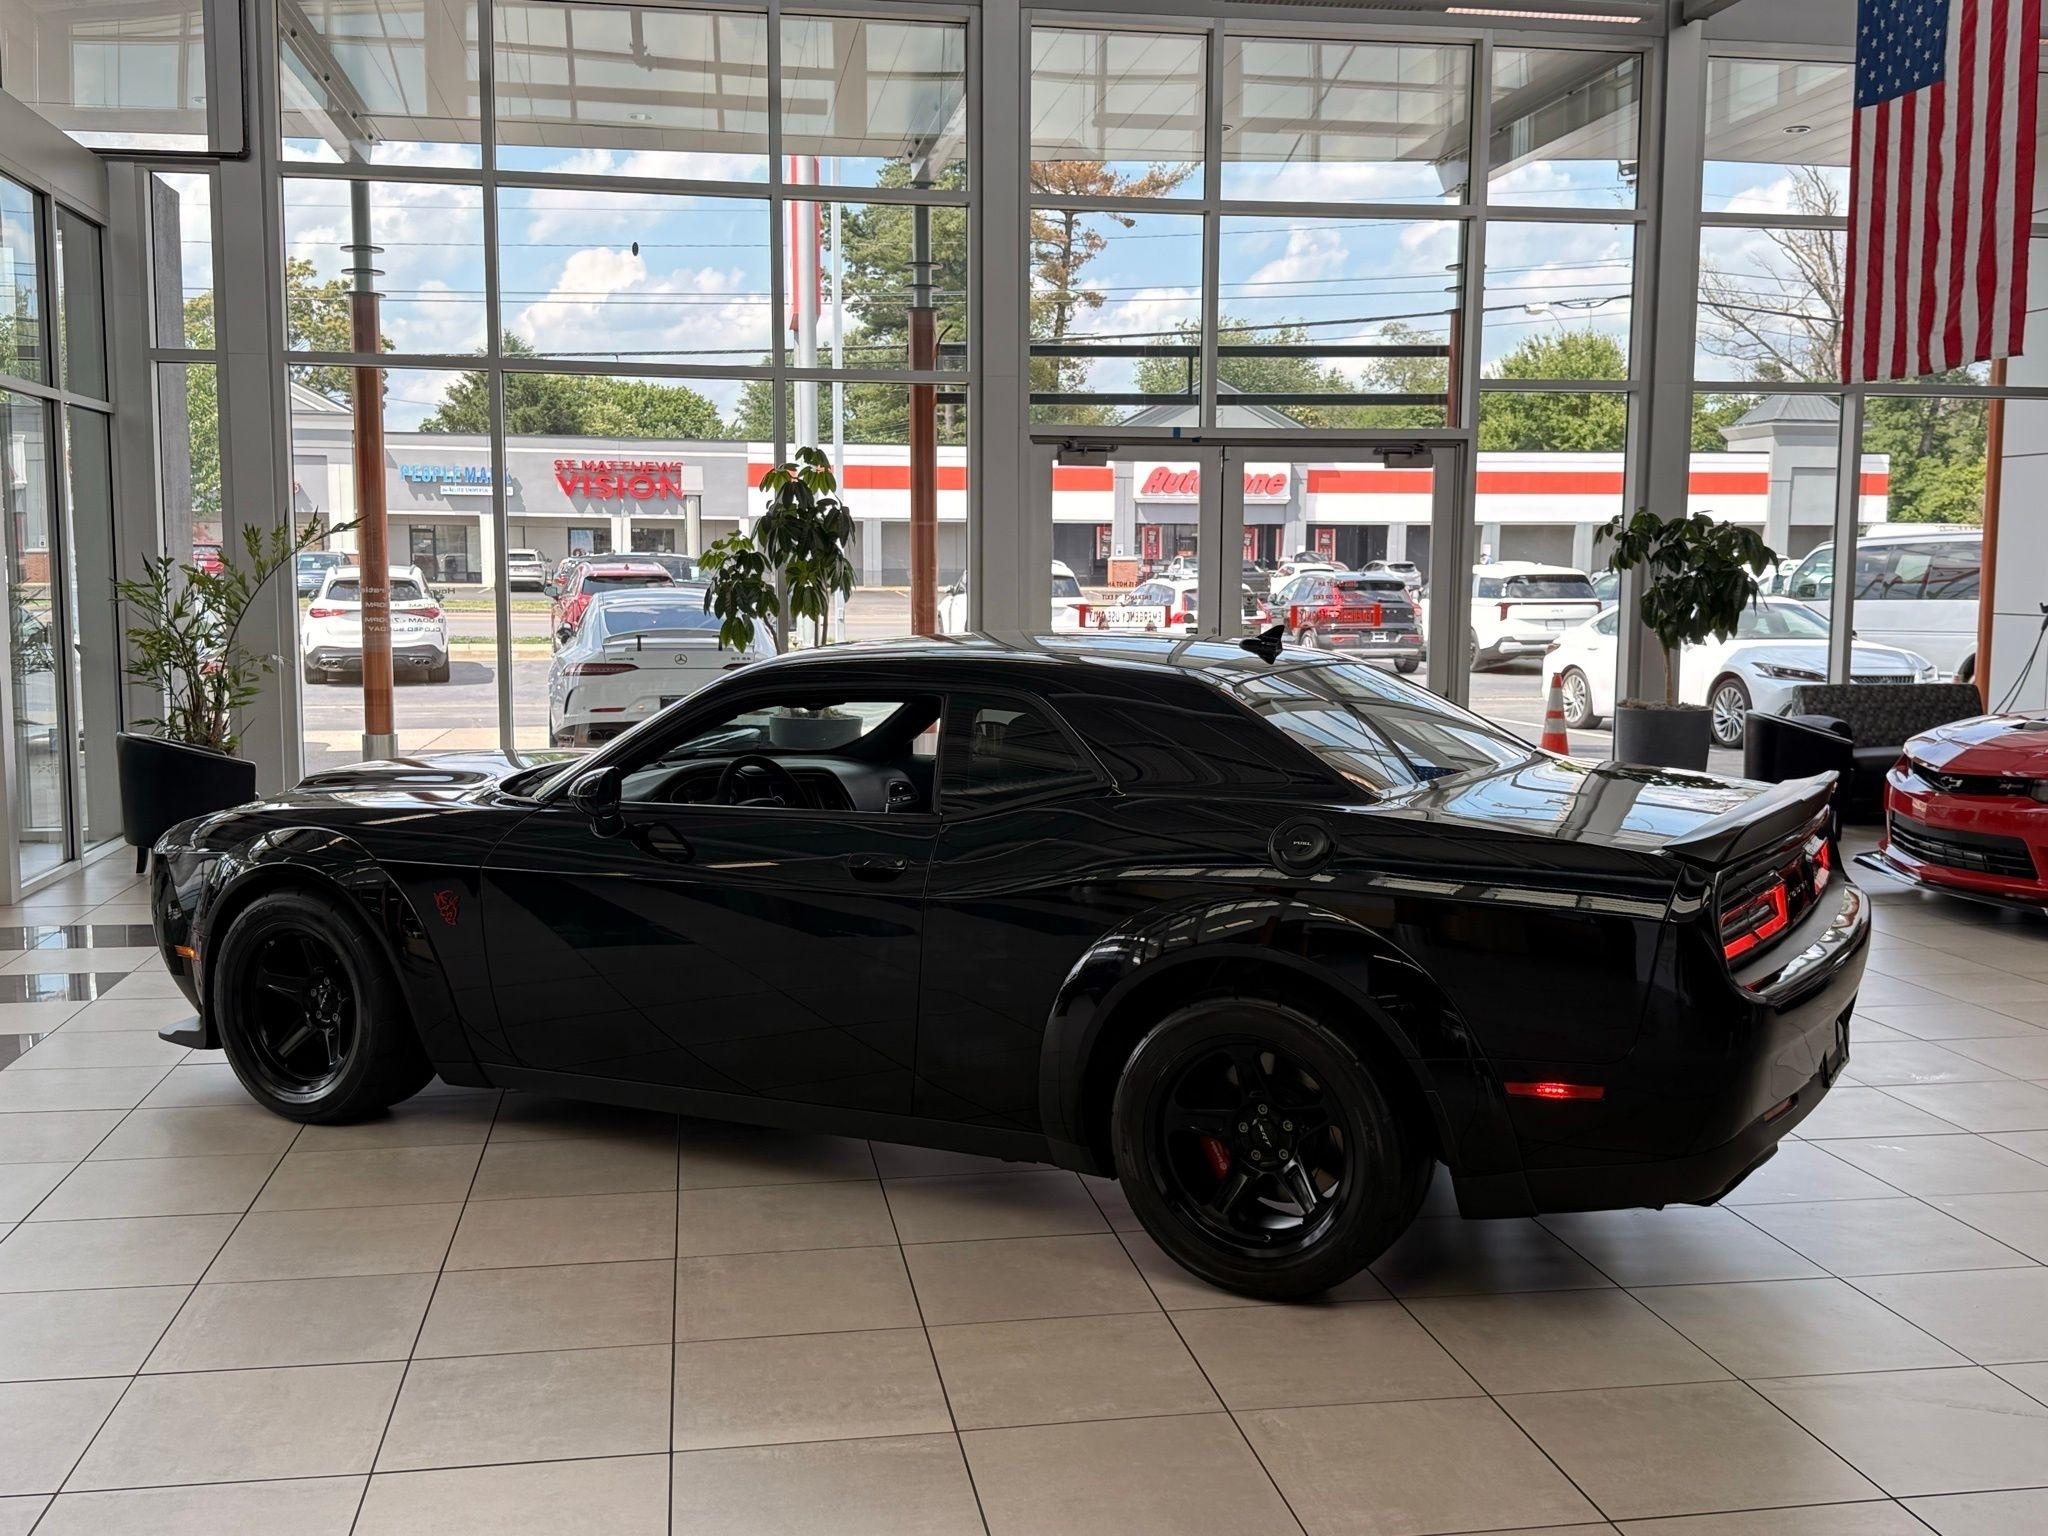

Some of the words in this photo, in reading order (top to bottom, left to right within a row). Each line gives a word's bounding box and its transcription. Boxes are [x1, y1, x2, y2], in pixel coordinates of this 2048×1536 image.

[400, 464, 461, 483] PEOPLE
[581, 460, 684, 473] MATTHEWS
[555, 472, 684, 500] VISION
